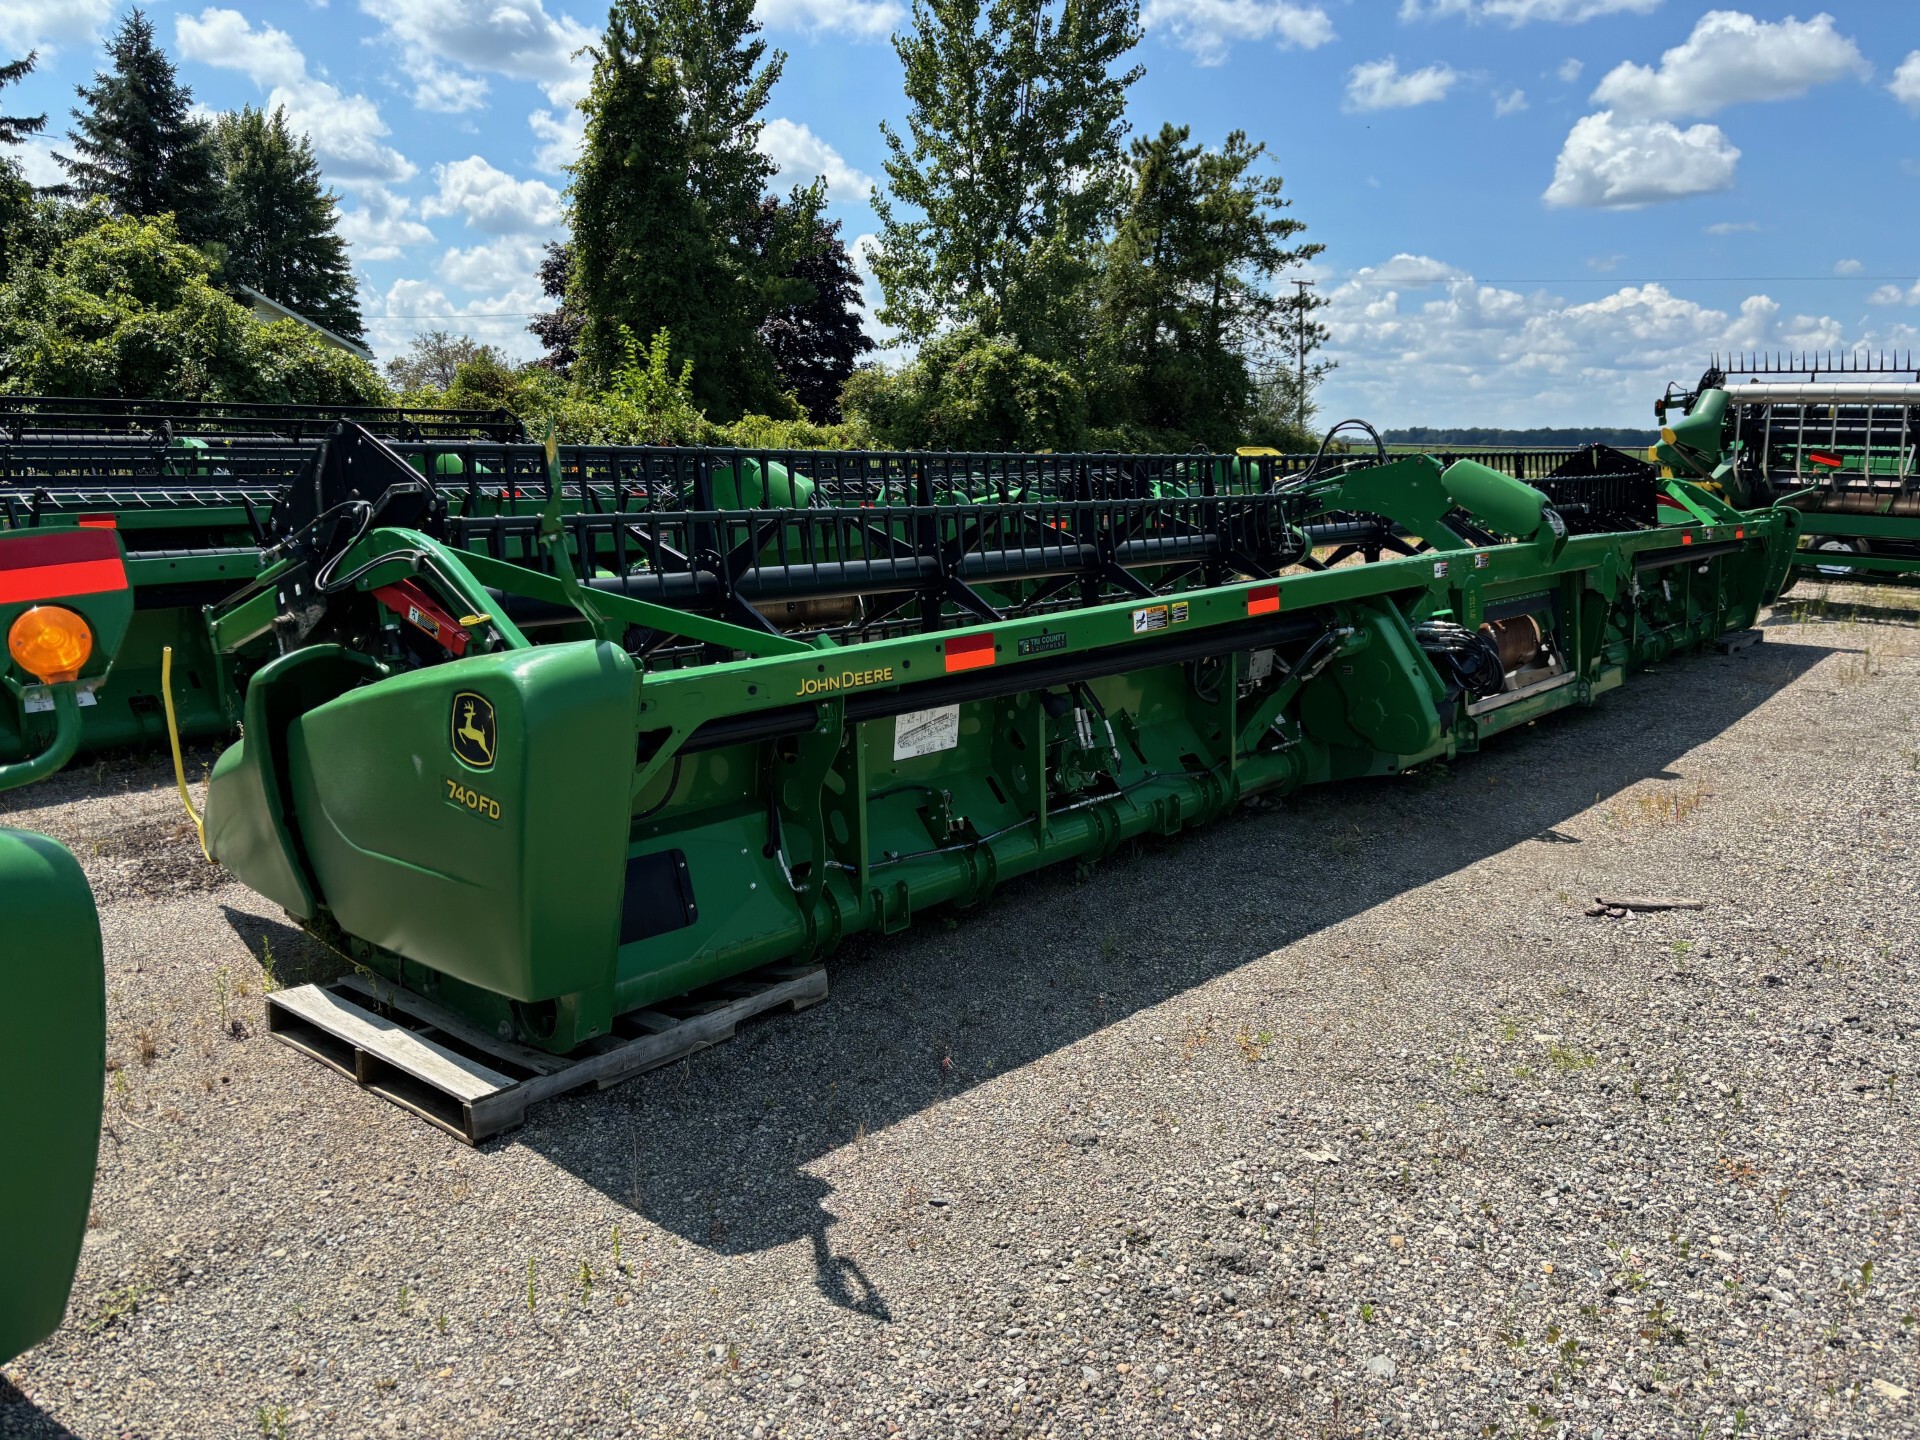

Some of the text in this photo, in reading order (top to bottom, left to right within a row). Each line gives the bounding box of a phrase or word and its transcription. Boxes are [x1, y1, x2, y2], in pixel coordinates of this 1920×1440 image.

[1030, 633, 1066, 646] TRI COUNTY
[796, 667, 893, 696] JOHN DEERE
[446, 779, 501, 820] 740FD
